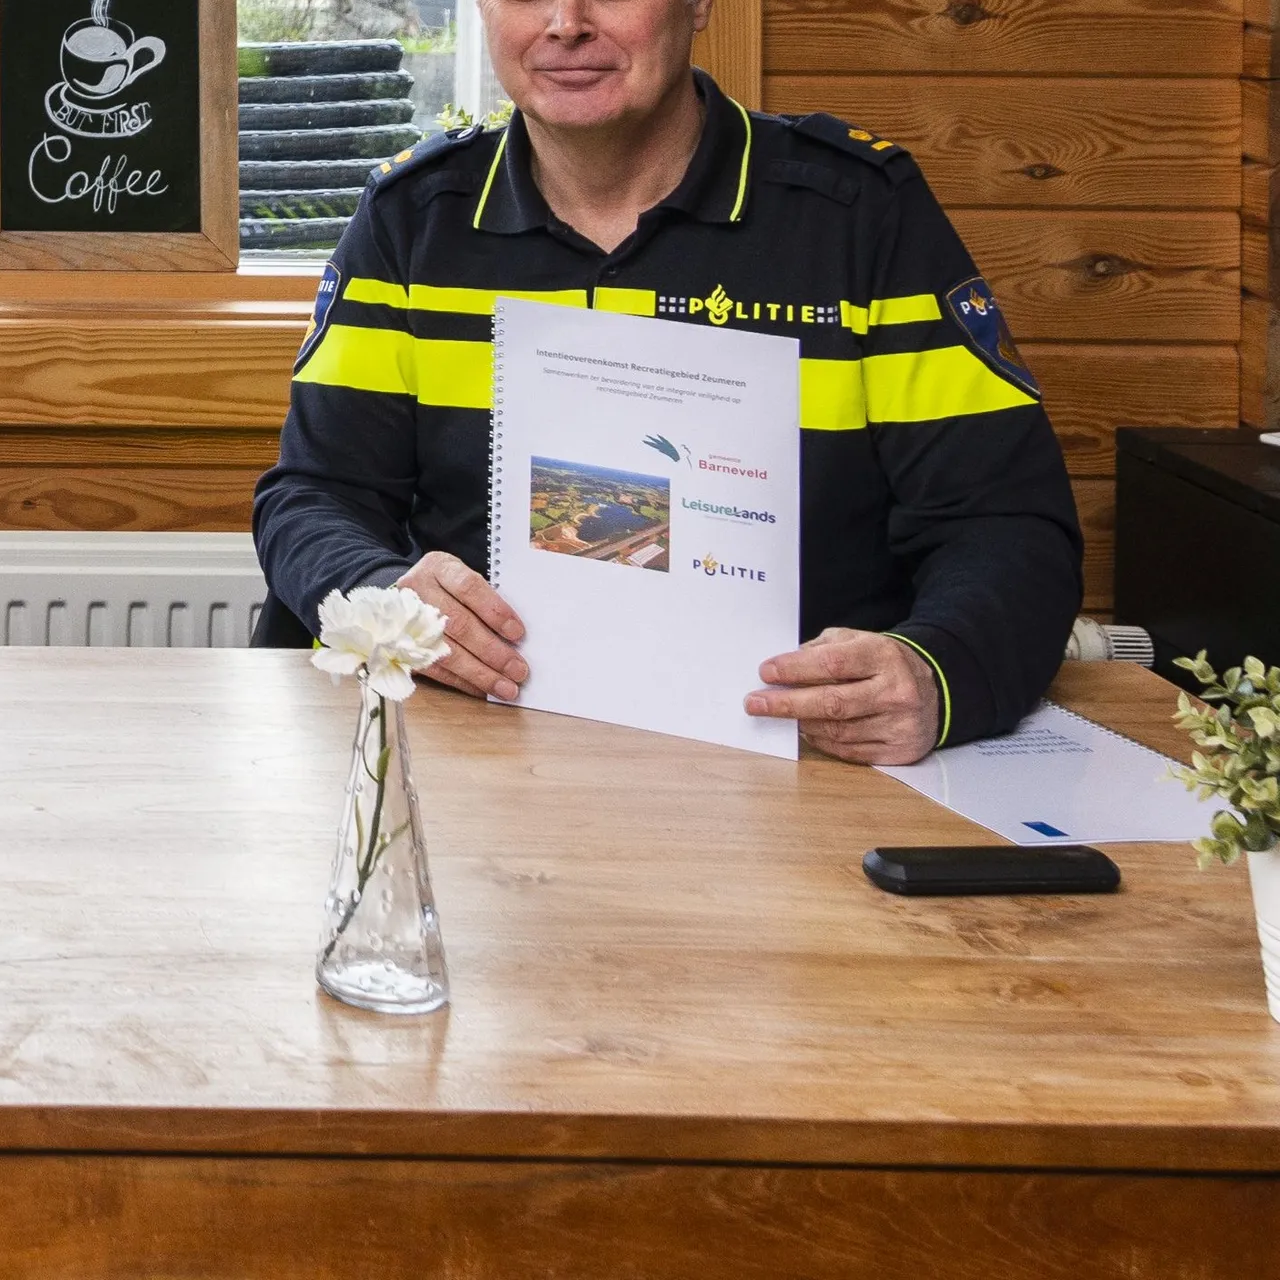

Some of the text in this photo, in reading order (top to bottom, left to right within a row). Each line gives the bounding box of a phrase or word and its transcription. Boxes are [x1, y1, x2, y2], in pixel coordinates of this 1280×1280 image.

[53, 102, 151, 134] BUT FIRST
[28, 132, 169, 214] Coffee
[689, 292, 815, 325] POLITIE
[536, 348, 747, 388] Intentieovereenkomst Recreatiegebied Zeumeren
[543, 367, 741, 405] Samenwerken ter bevordering van de integrale veiligheid op
[596, 386, 683, 405] recreatiegebied Zeumeren
[698, 460, 768, 480] Barneveld
[682, 497, 776, 524] LeisureLands
[693, 557, 766, 582] POLITIE
